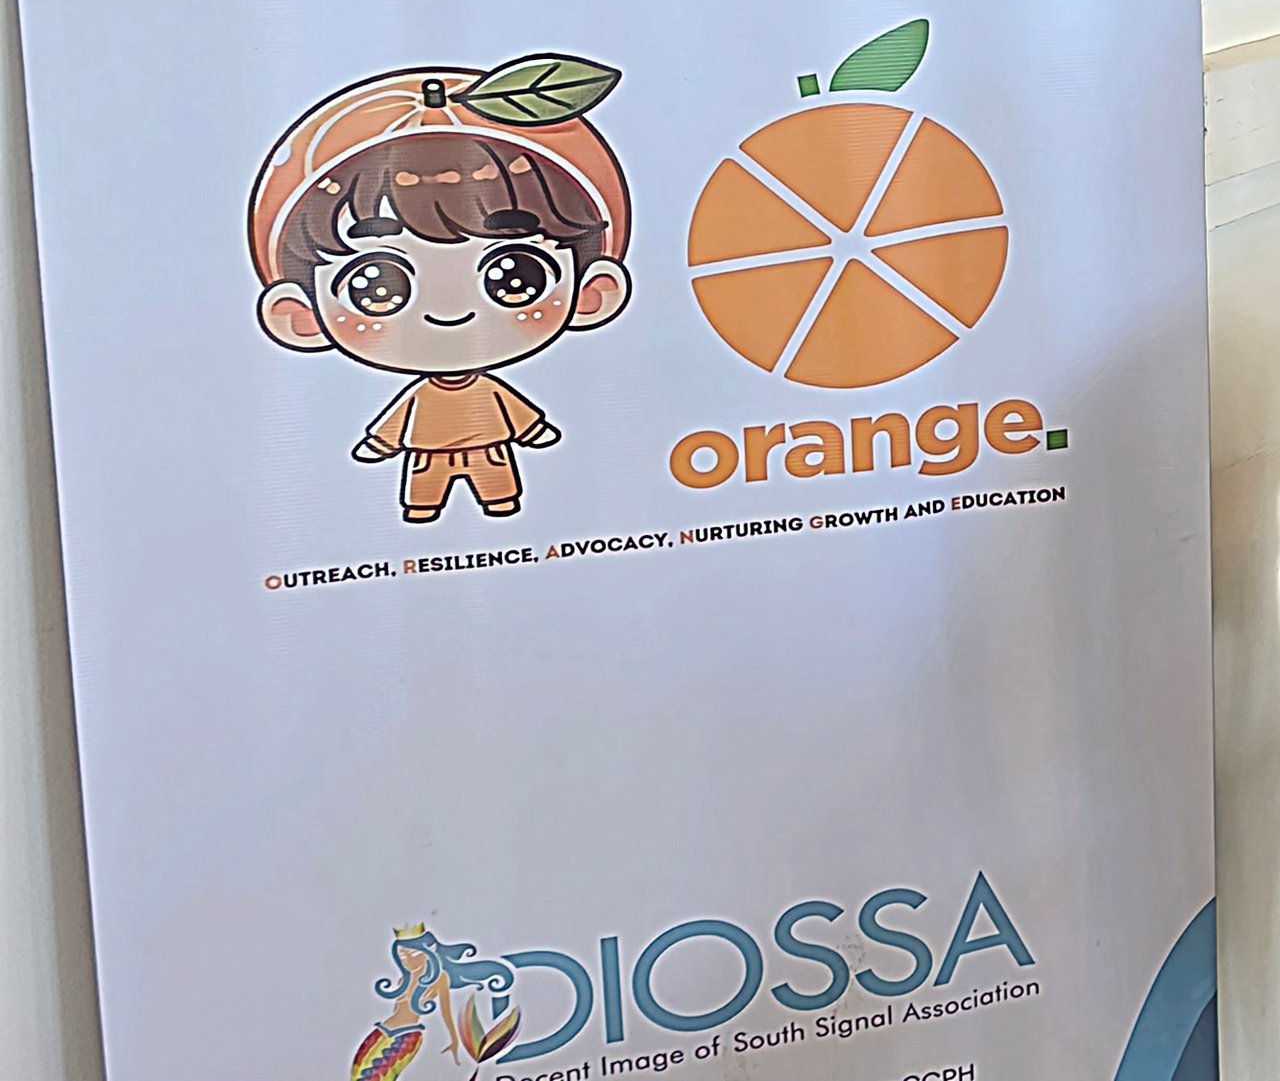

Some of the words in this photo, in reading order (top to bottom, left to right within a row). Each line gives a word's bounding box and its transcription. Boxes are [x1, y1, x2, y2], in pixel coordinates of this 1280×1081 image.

[680, 517, 804, 544] NURTURING
[809, 506, 898, 530] GROWTH
[903, 498, 945, 520] AND
[951, 487, 1066, 511] EDUCATION
[492, 870, 1037, 1064] DIOSSA
[601, 1048, 684, 1076] Image
[695, 1035, 721, 1060] of
[734, 1022, 804, 1053] South
[815, 1006, 892, 1039] Signal
[903, 981, 1039, 1023] Association
